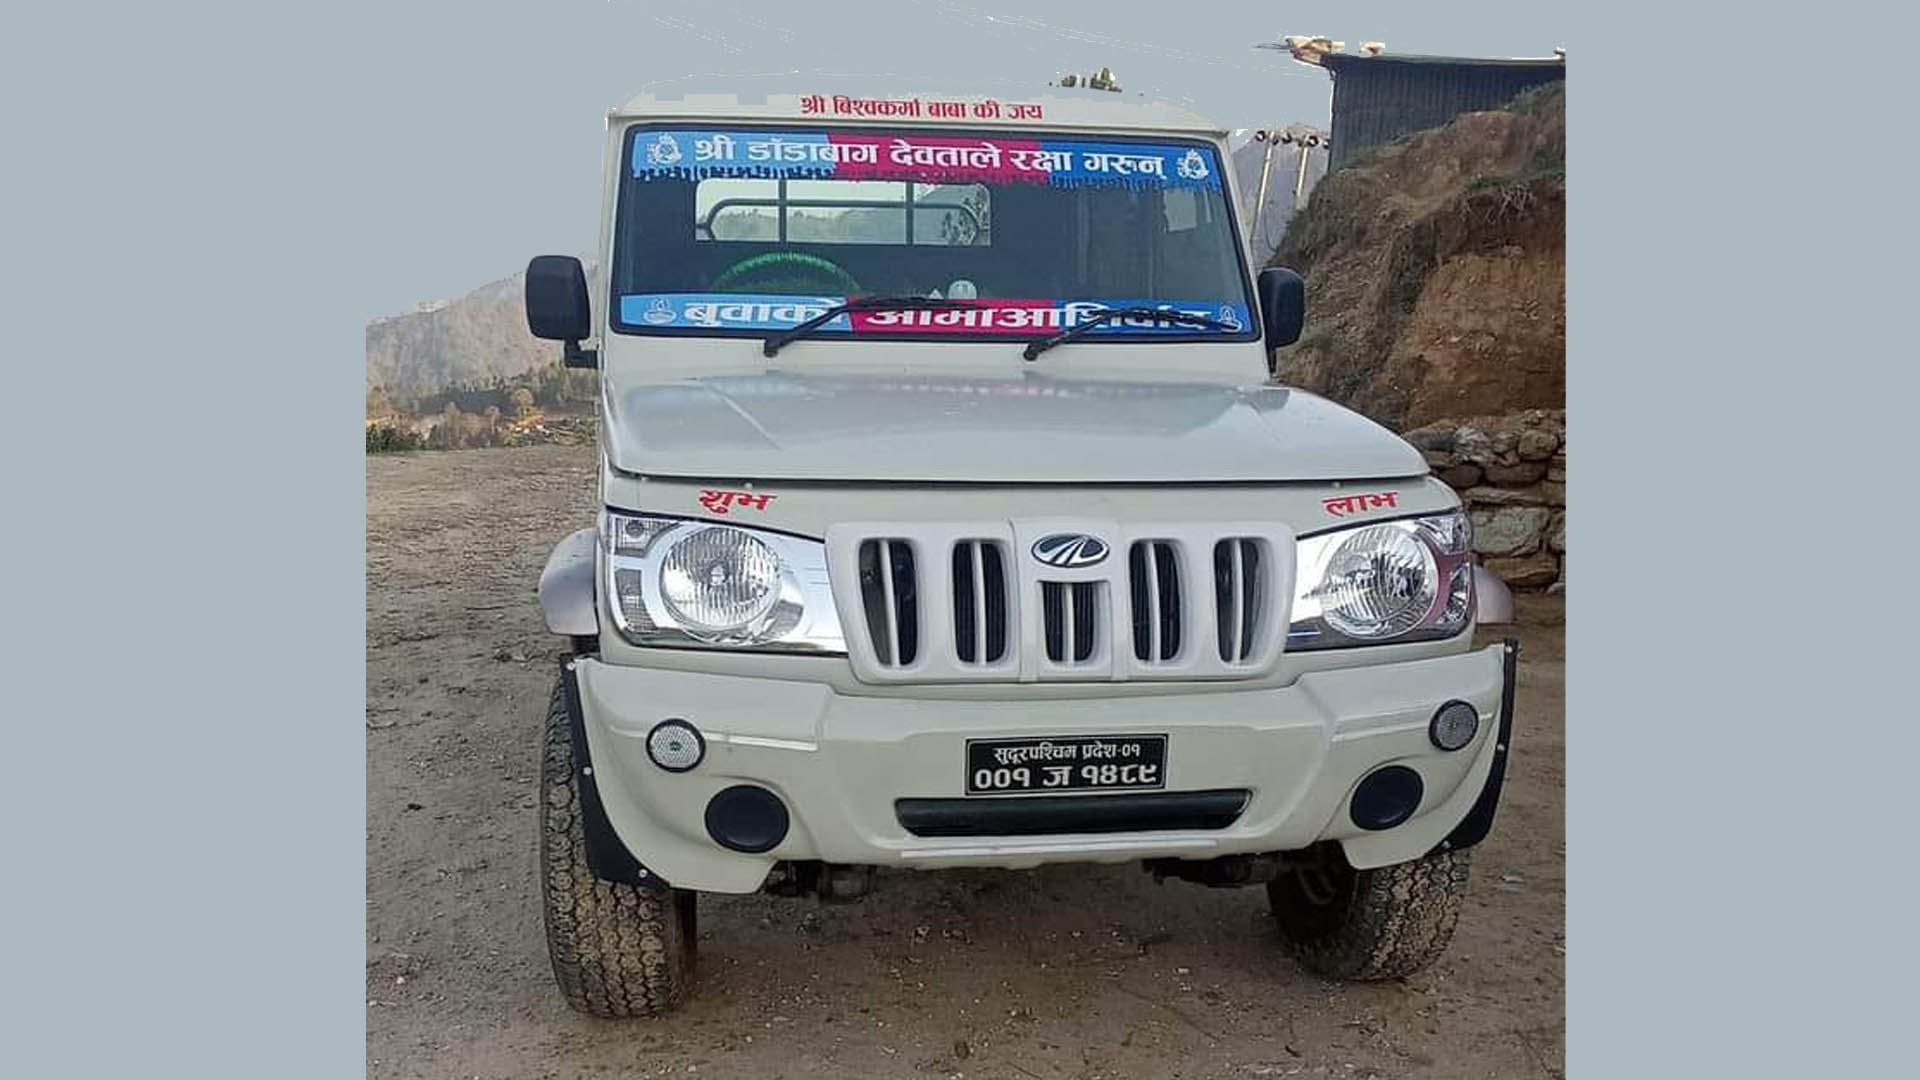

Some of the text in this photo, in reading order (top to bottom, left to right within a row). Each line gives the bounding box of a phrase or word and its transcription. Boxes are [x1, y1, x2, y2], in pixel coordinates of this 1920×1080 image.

[800, 95, 826, 116] श्री
[928, 101, 966, 119] बाबा
[1007, 103, 1043, 119] जय
[695, 134, 736, 161] श्री
[890, 138, 1002, 169] देवताले
[1010, 149, 1073, 173] रक्षा
[698, 490, 779, 515] शुभ
[1321, 490, 1399, 518] लाभ
[992, 740, 1077, 765] सुदूरपश्चिम
[974, 767, 1031, 789] ००१
[1042, 765, 1073, 787] ज
